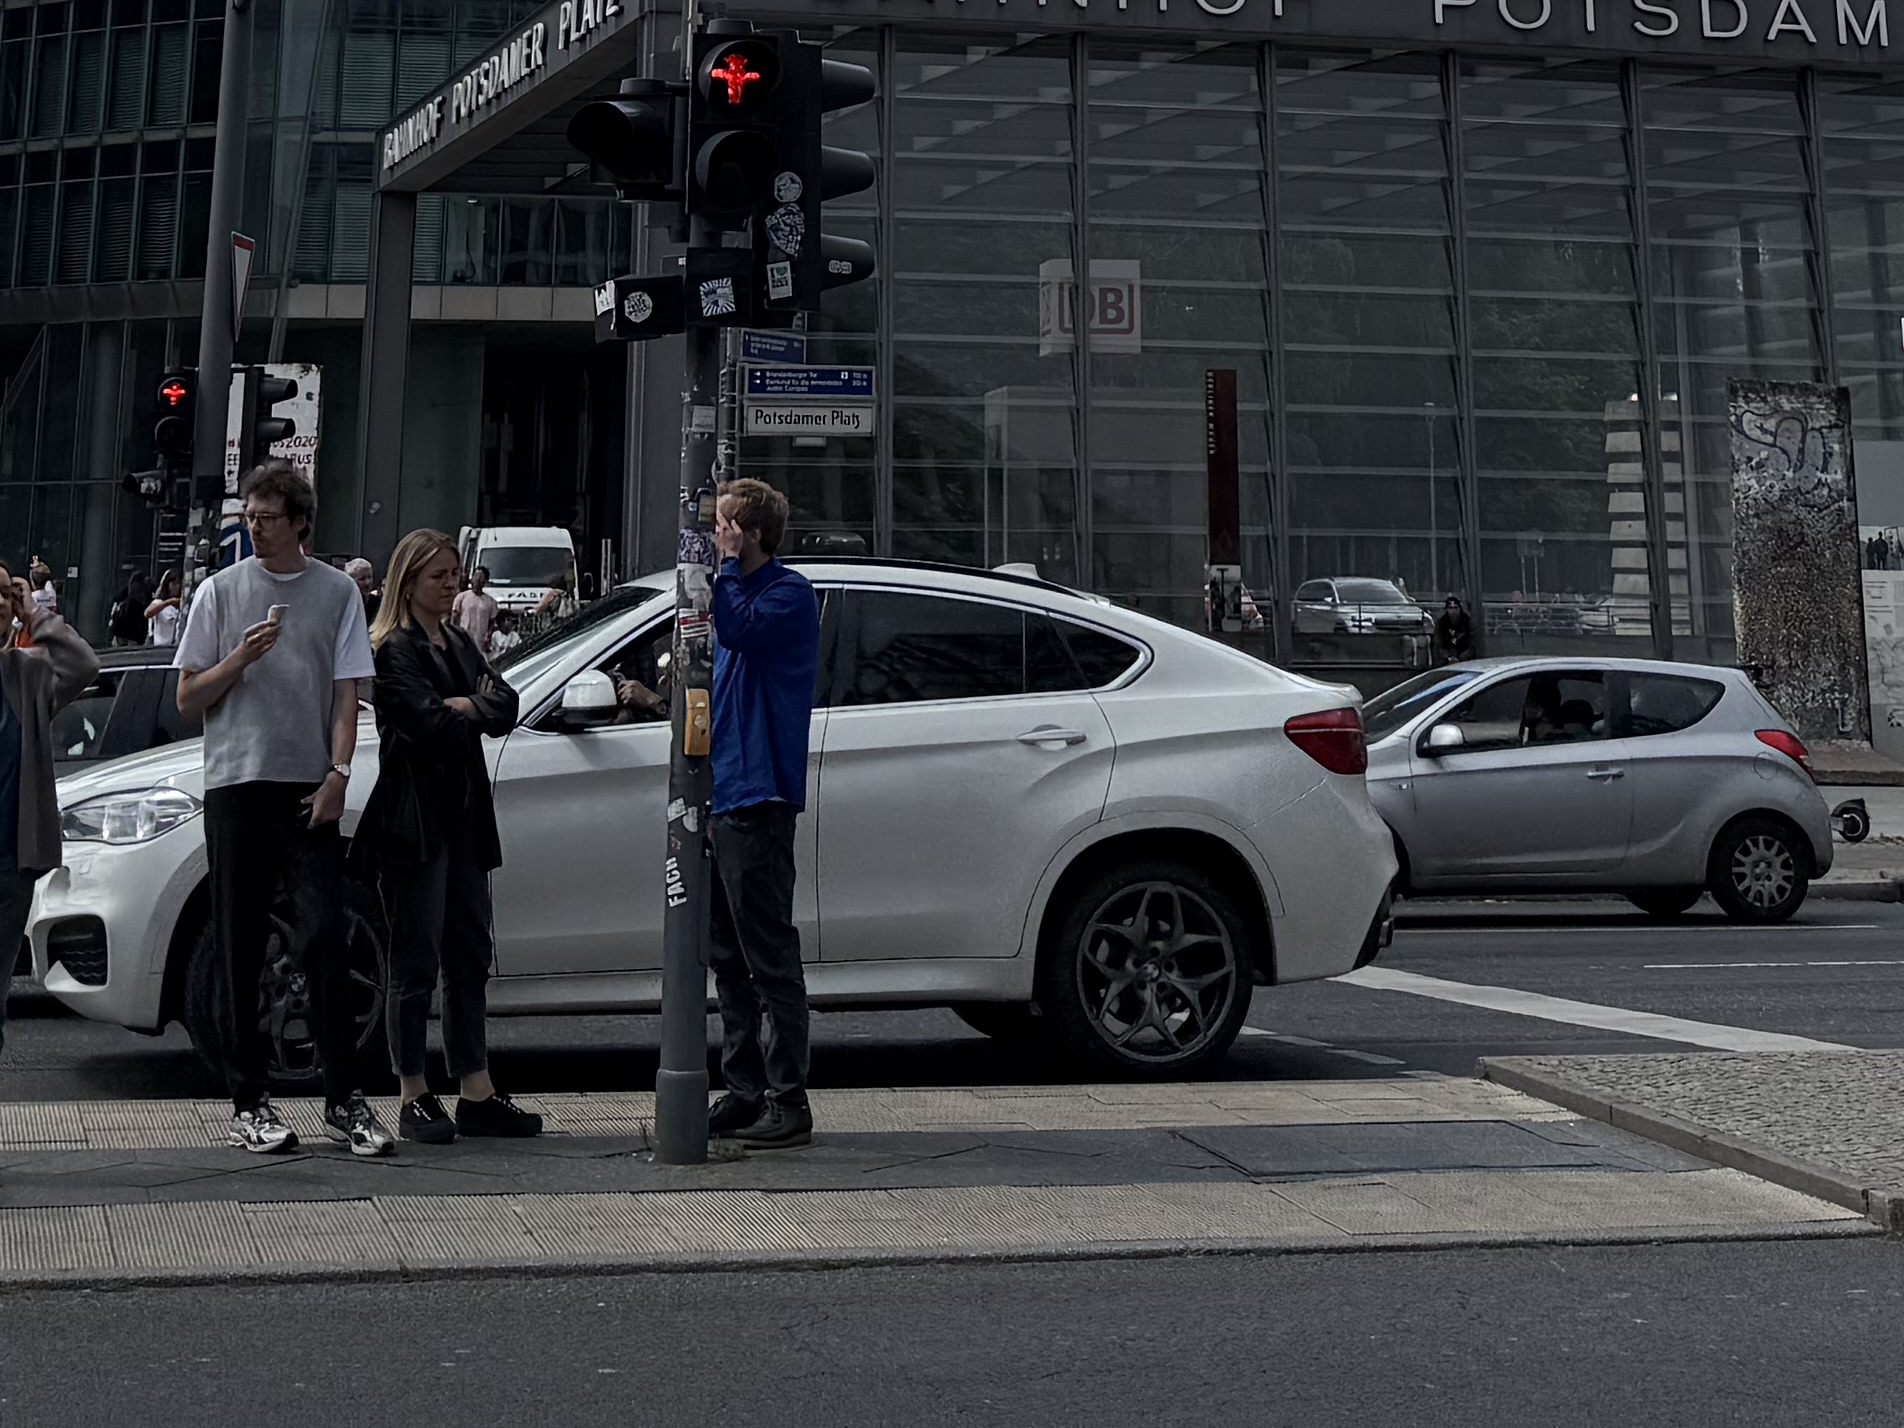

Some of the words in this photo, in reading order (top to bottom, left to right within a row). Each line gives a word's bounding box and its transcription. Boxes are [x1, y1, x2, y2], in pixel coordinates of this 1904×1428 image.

[383, 95, 446, 170] BAHNHOF
[451, 21, 548, 125] POTSDAMER
[755, 409, 827, 426] Potsdamer
[831, 410, 860, 429] Platz
